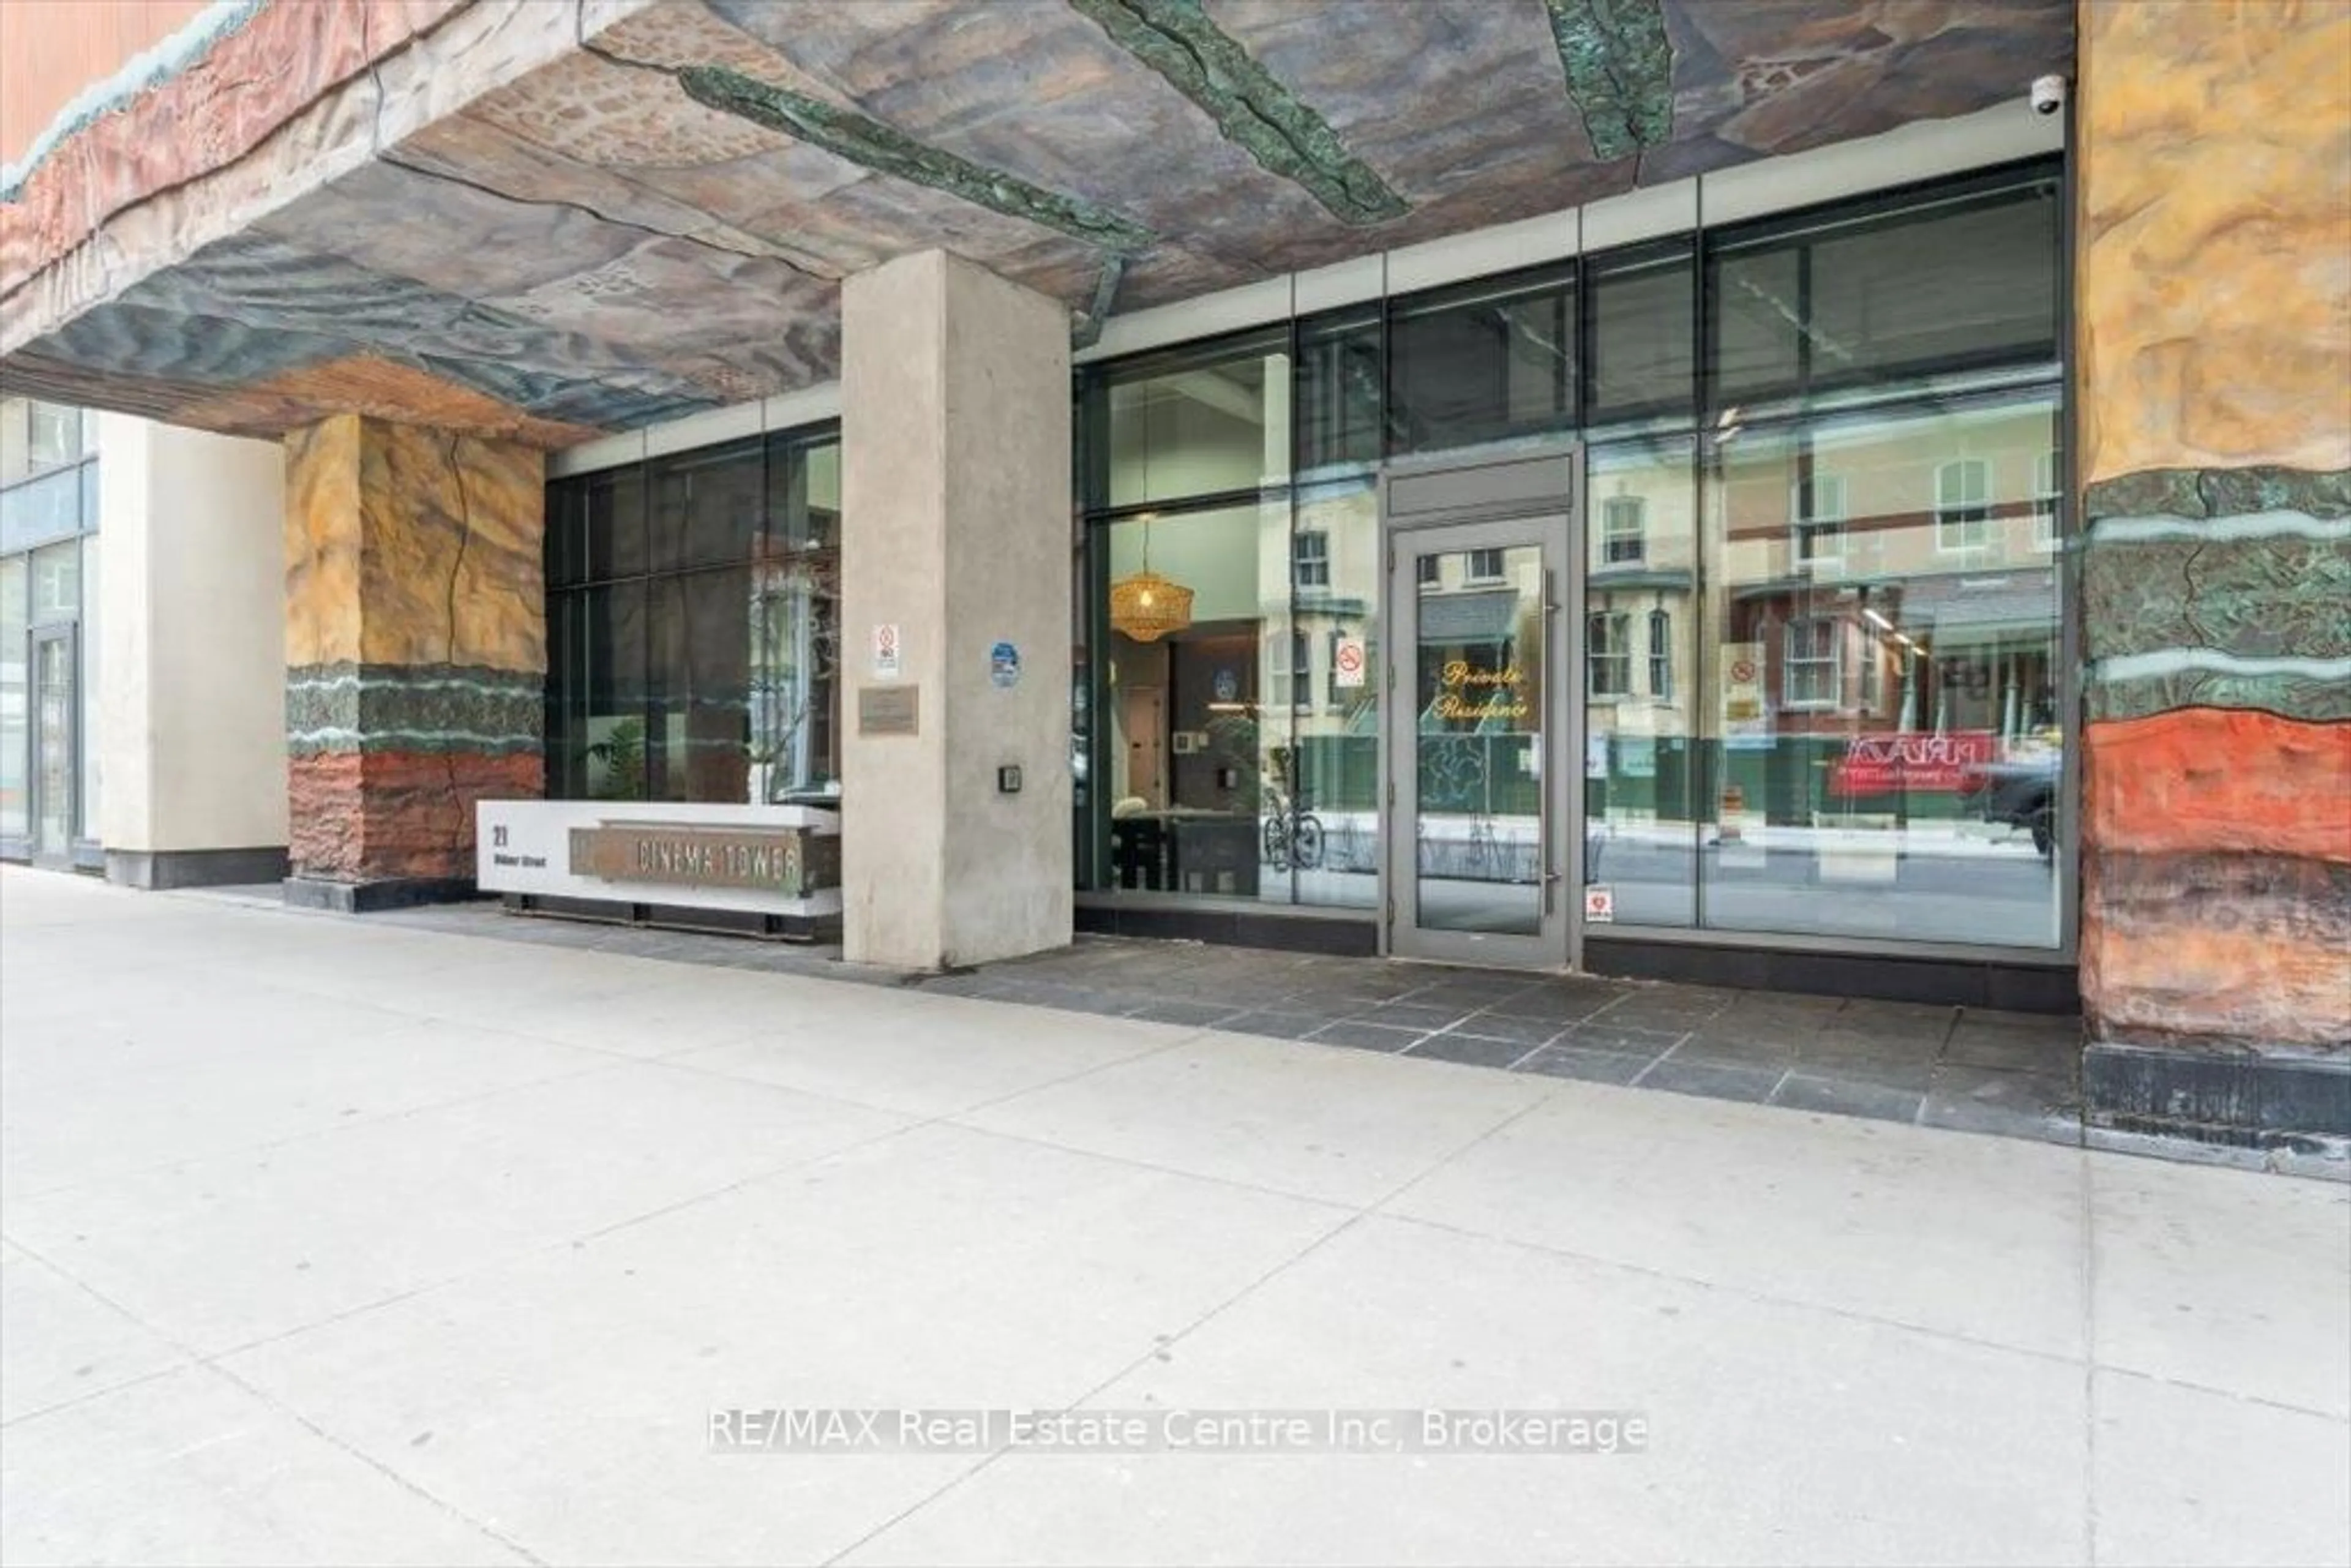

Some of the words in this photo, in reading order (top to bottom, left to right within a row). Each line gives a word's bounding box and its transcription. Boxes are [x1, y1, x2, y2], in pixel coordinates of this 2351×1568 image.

[1442, 661, 1522, 685] Private
[640, 841, 713, 877] CINEMA
[726, 844, 797, 880] TOWER
